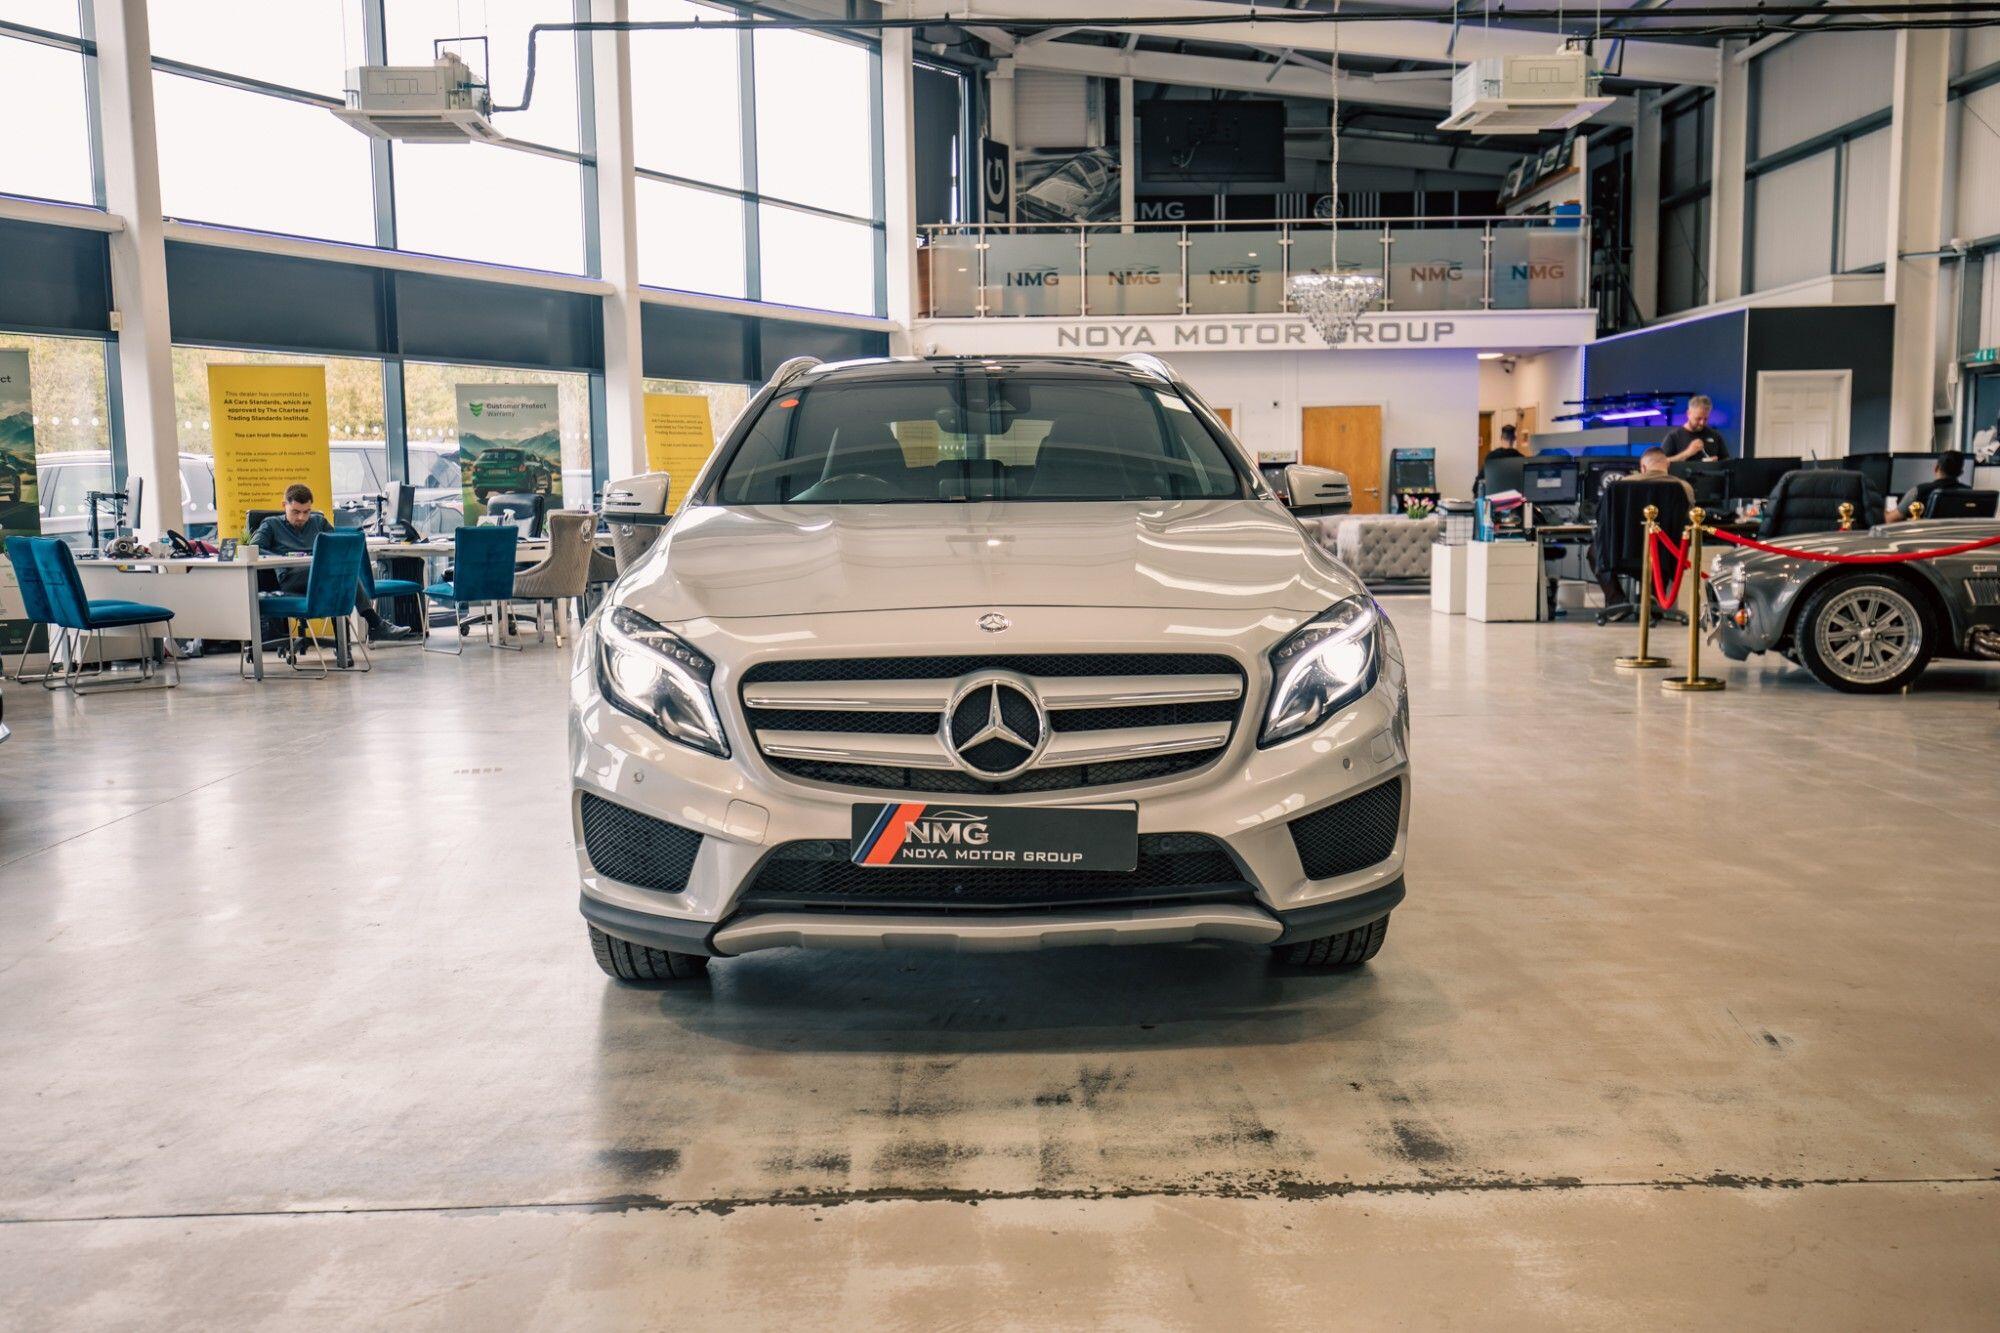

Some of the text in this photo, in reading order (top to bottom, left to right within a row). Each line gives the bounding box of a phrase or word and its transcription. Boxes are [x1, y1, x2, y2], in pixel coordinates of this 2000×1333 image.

[1006, 271, 1060, 287] NMG
[1108, 270, 1161, 285] NMG
[1208, 269, 1261, 284] NMG
[1411, 265, 1463, 282] NMG
[1512, 264, 1565, 280] NMG
[1057, 321, 1455, 347] NOYA MOTOR ROUP
[486, 402, 519, 410] Customer
[903, 820, 990, 845] NMG
[902, 848, 1084, 863] NOYA MOTOR GROUP
